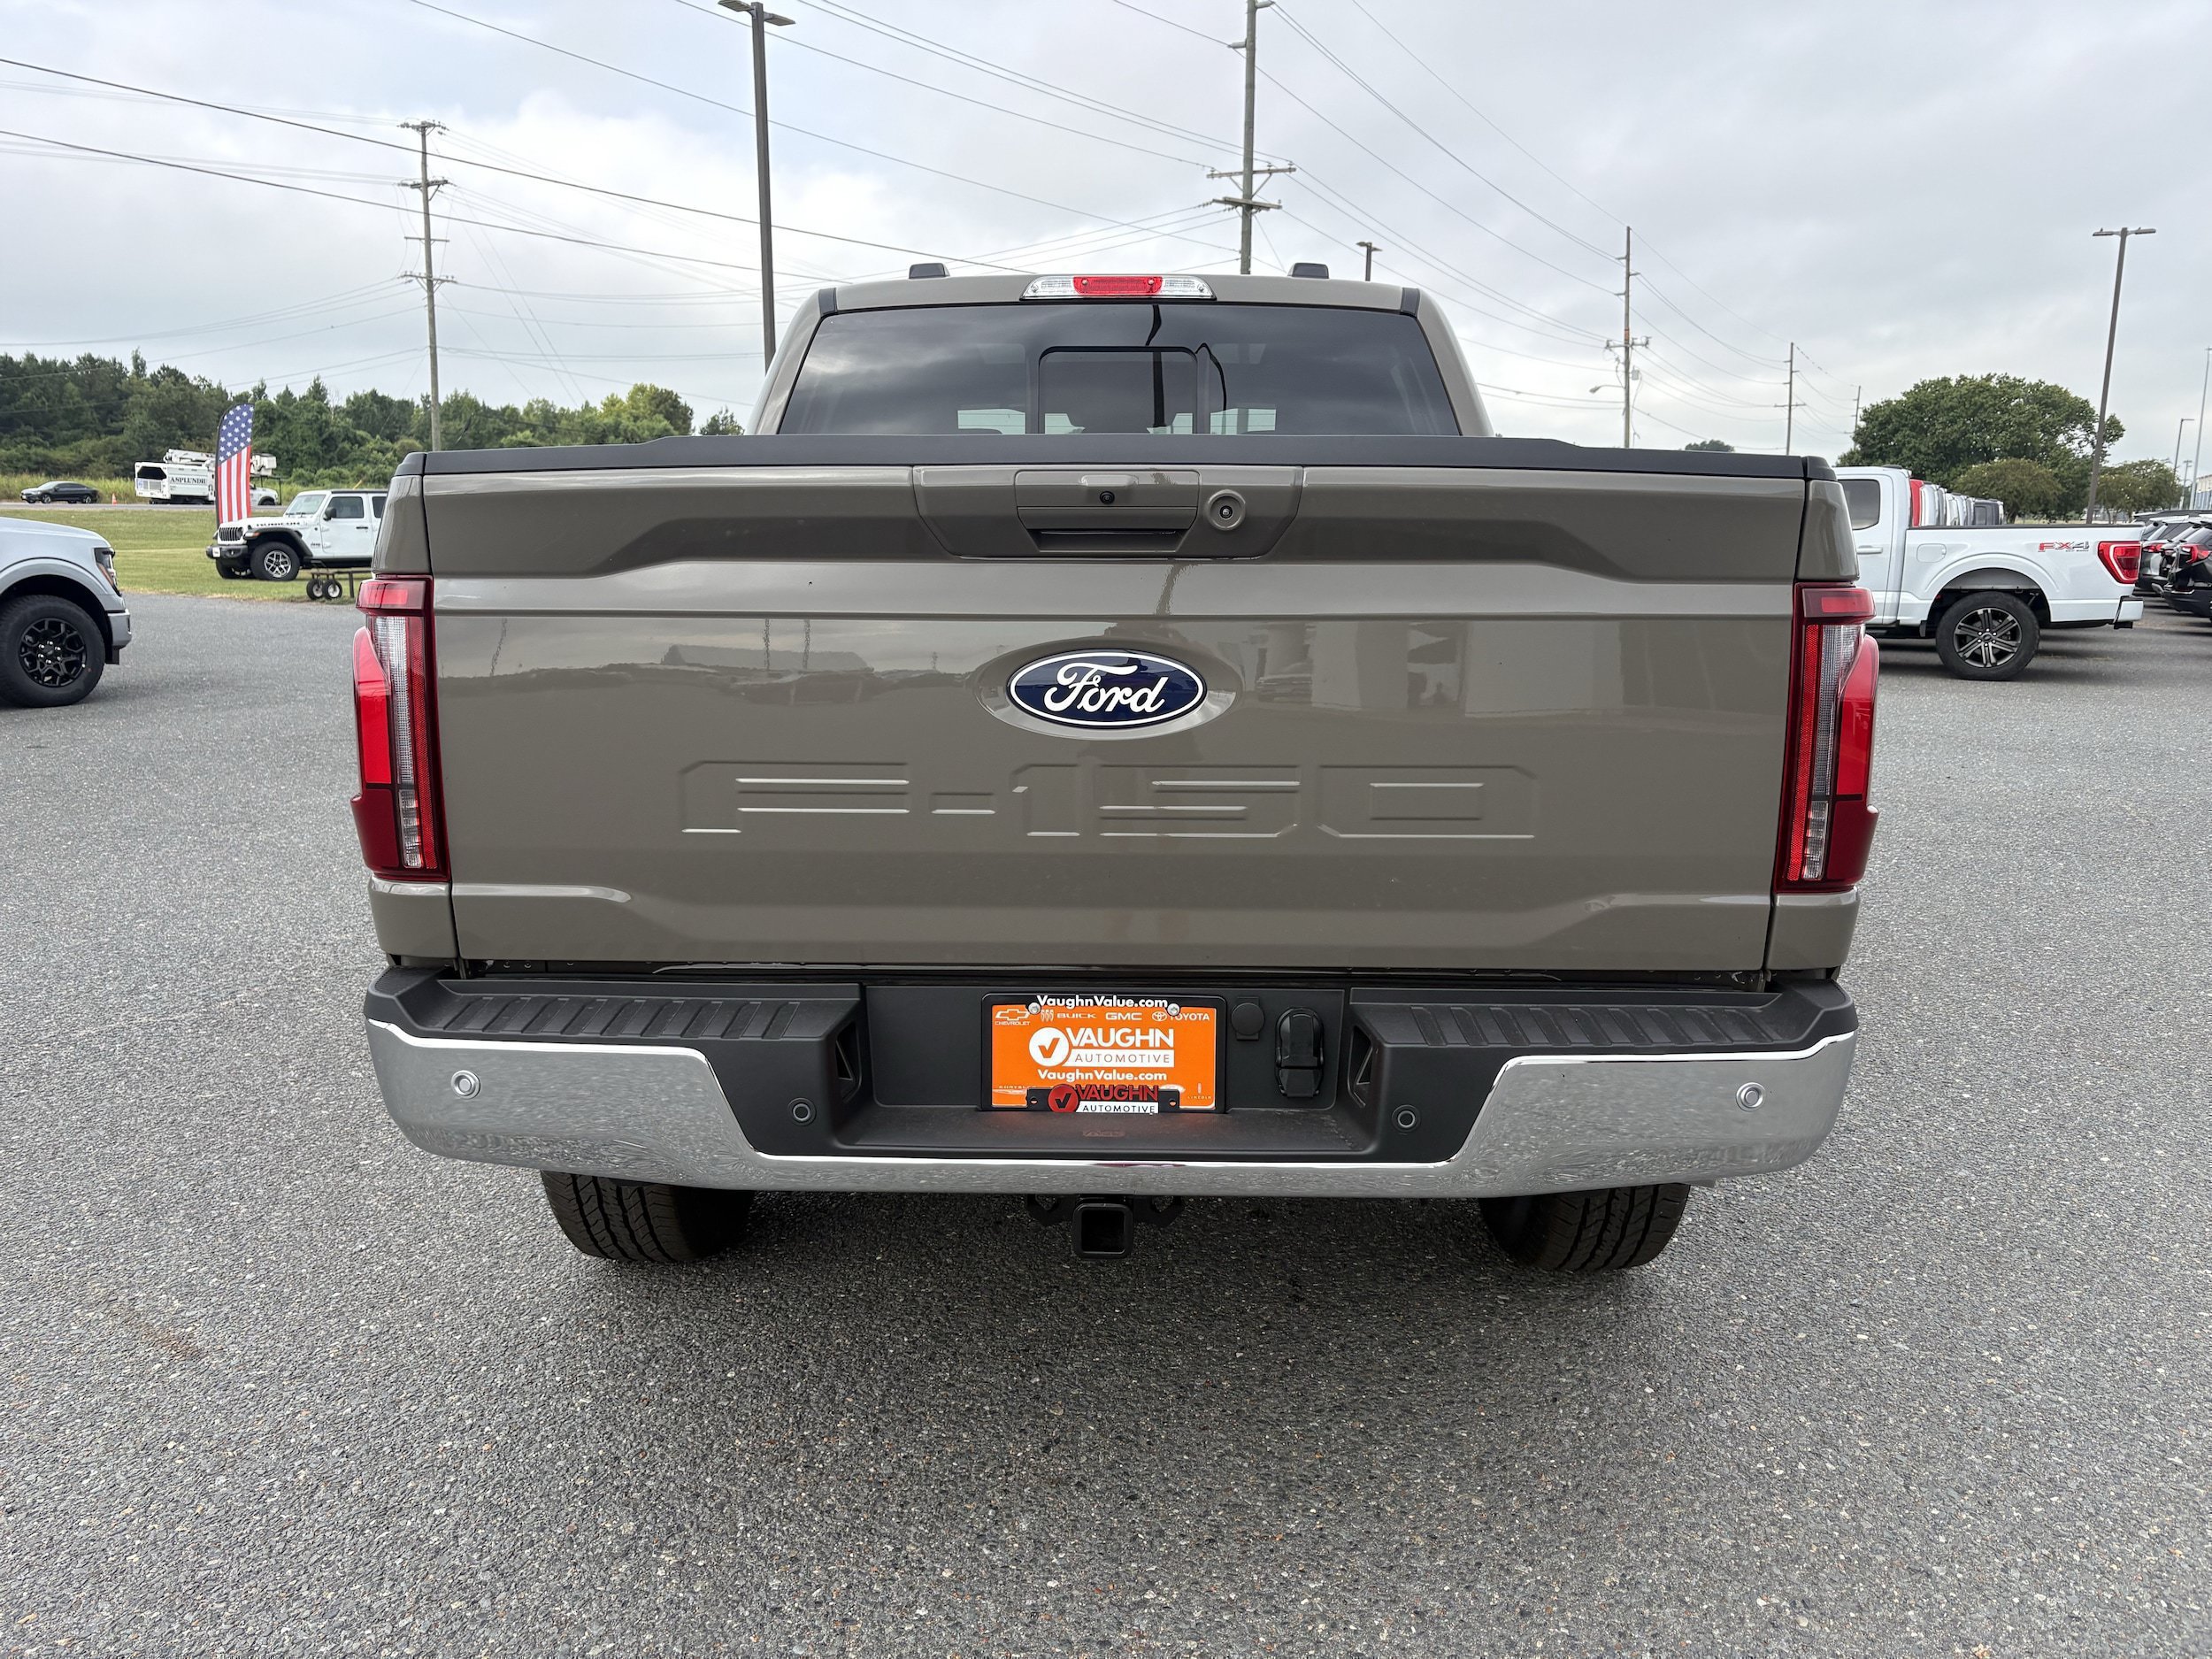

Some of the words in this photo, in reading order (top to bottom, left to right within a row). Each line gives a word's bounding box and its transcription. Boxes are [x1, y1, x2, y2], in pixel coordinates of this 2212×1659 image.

[2038, 541, 2089, 552] FX4
[1043, 662, 1169, 712] Ford
[681, 762, 1537, 838] F-150
[1037, 995, 1168, 1010] VaughnValue.com
[1065, 1027, 1174, 1048] VAUGHN
[1075, 1053, 1170, 1064] AUTOMOTIVE
[1037, 1069, 1167, 1082] VaughnValue.com
[1076, 1084, 1158, 1101] VAUGHN
[1083, 1104, 1155, 1113] AUTOMOTIVE
